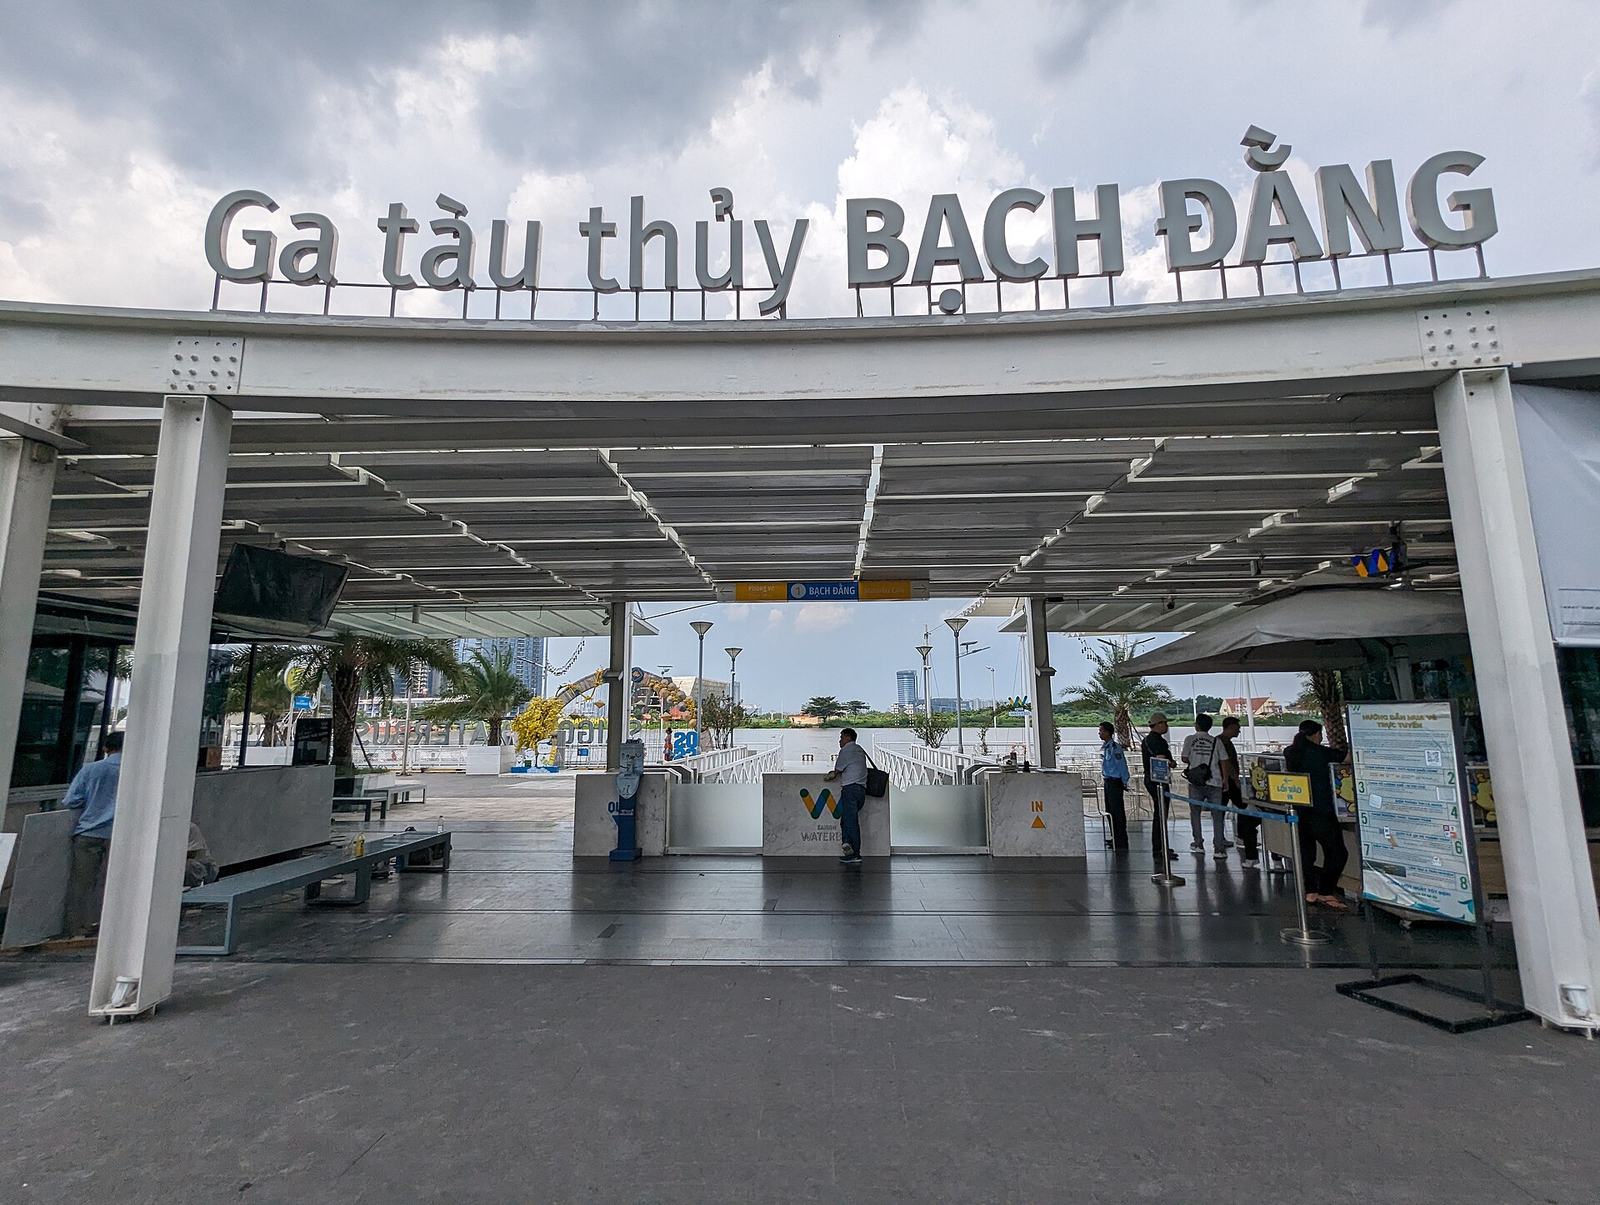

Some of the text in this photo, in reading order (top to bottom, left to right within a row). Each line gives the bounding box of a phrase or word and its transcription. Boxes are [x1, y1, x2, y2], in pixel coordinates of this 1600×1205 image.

[204, 124, 1499, 317] Ga tàu thủy BẠCH ĐẰNG
[808, 586, 831, 597] BẠCH
[832, 583, 856, 595] ĐẰNG
[673, 731, 698, 748] 20
[1356, 751, 1360, 762] 1
[1447, 771, 1455, 785] 2
[1358, 781, 1365, 793] 3
[1031, 800, 1044, 812] IN
[1450, 806, 1458, 819] 4
[1361, 812, 1368, 825] 5
[801, 831, 842, 842] WATERB
[1363, 843, 1370, 856] 7
[1454, 840, 1463, 855] 6
[1460, 876, 1468, 890] 8
